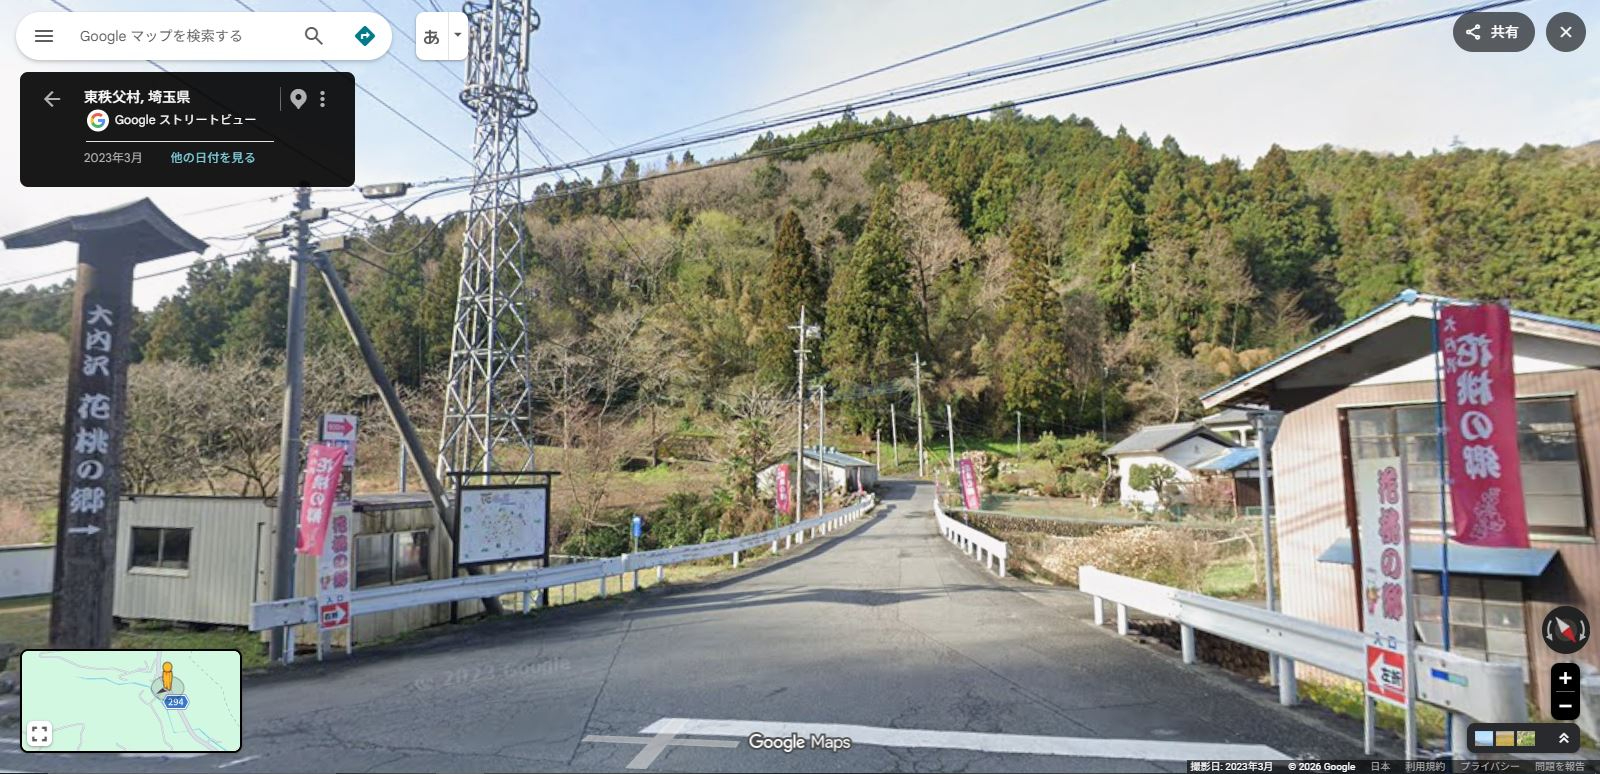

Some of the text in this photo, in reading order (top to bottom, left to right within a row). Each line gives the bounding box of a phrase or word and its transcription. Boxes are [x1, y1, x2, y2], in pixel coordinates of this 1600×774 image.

[70, 303, 114, 514] 大内沢 花桃の郷
